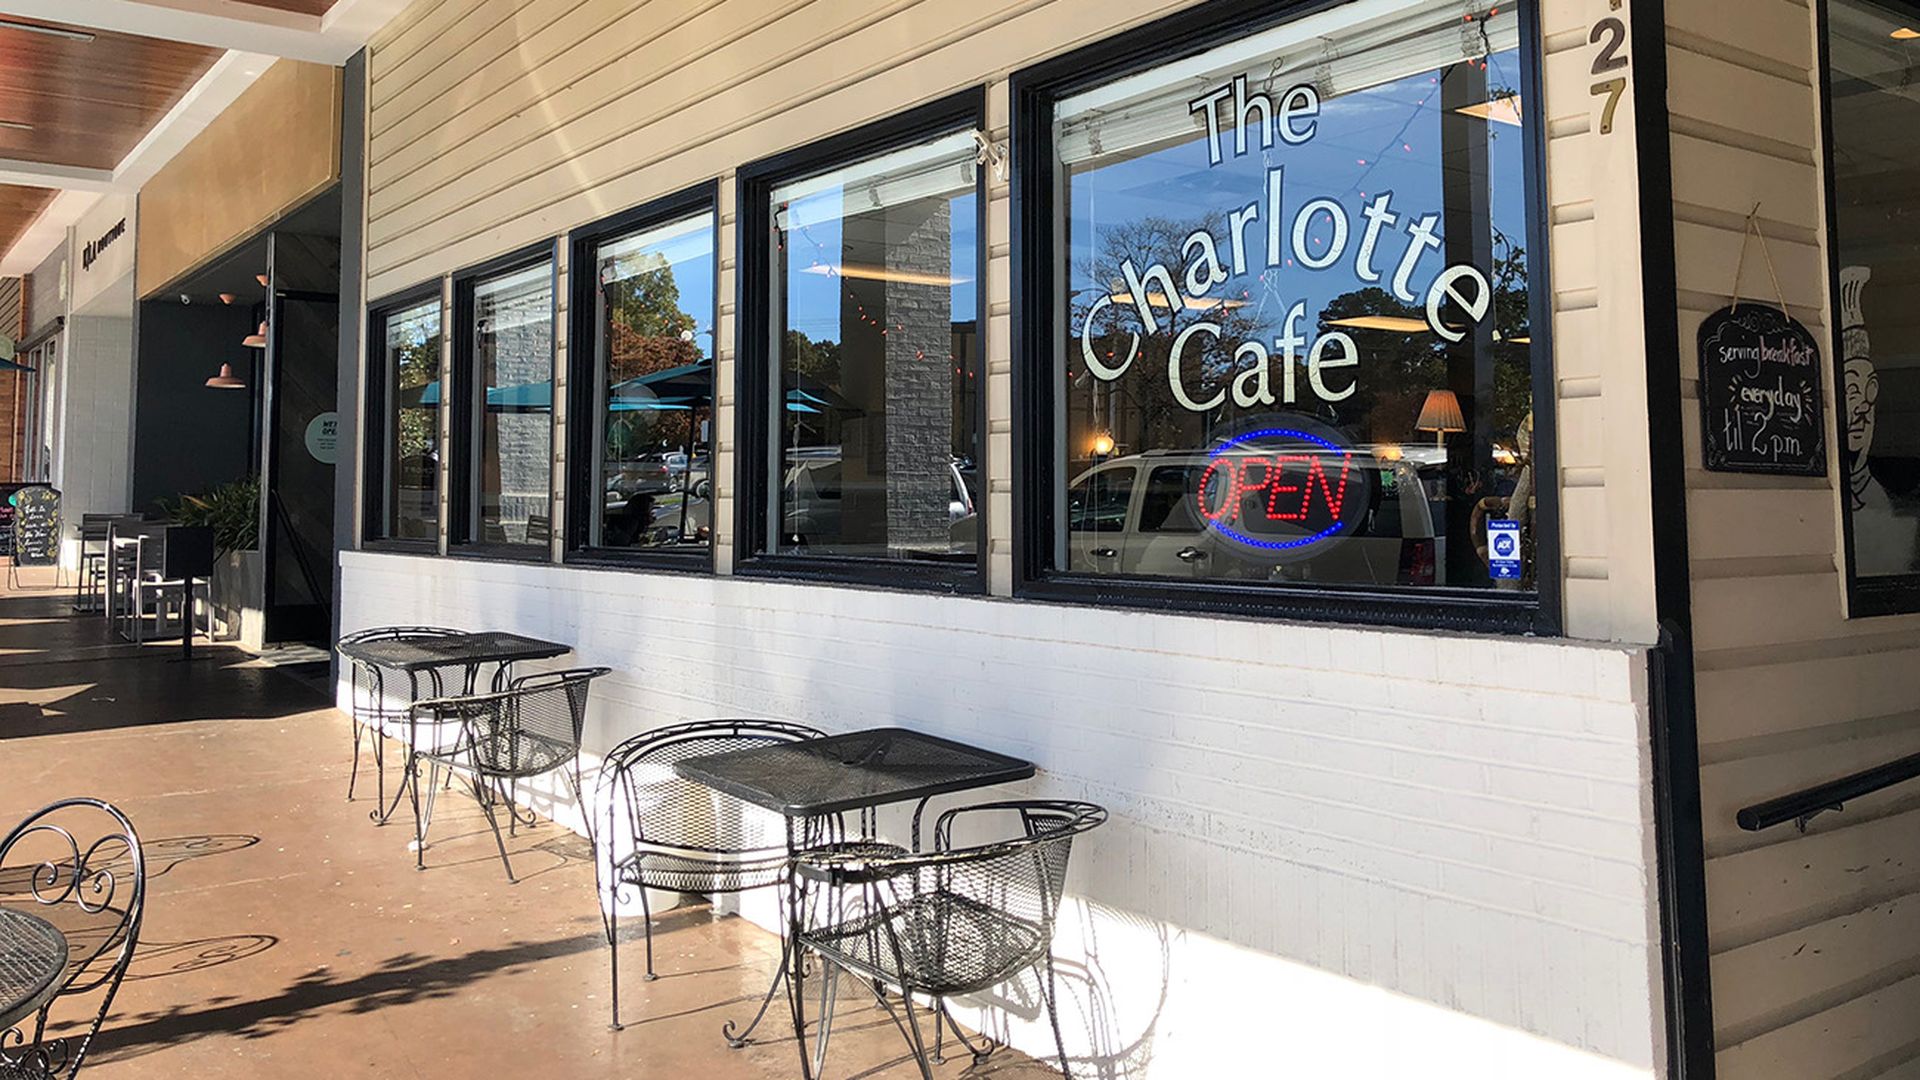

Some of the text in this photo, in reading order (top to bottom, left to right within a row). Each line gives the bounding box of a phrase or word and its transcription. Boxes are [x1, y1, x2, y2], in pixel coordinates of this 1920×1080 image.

[1589, 0, 1629, 135] 27
[1189, 73, 1321, 169] The
[1081, 166, 1492, 382] Charlotte
[1168, 298, 1360, 413] Cafe
[1719, 335, 1814, 379] serving breakfast
[1740, 376, 1803, 424] everyday
[1751, 412, 1769, 455] 2
[1197, 452, 1353, 521] OPEN
